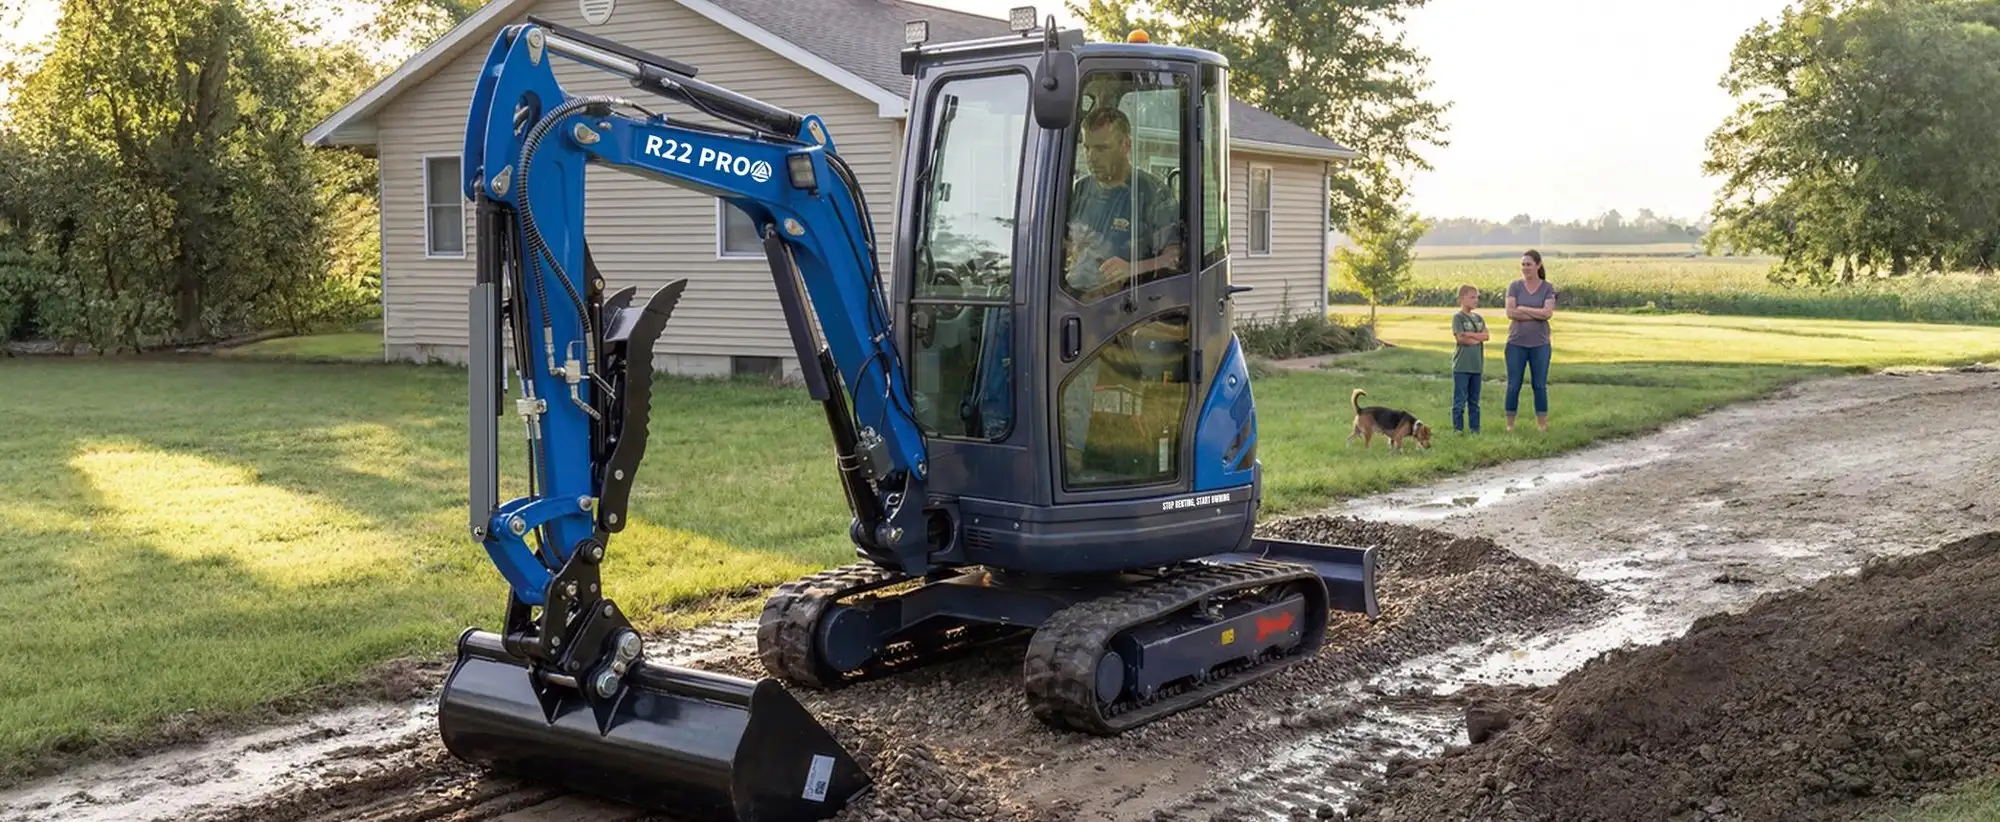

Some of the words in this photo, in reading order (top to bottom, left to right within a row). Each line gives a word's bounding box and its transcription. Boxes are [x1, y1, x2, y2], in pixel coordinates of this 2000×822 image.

[644, 134, 693, 164] R22
[698, 147, 751, 176] PRO
[1162, 501, 1175, 511] STOP
[1196, 495, 1211, 506] START
